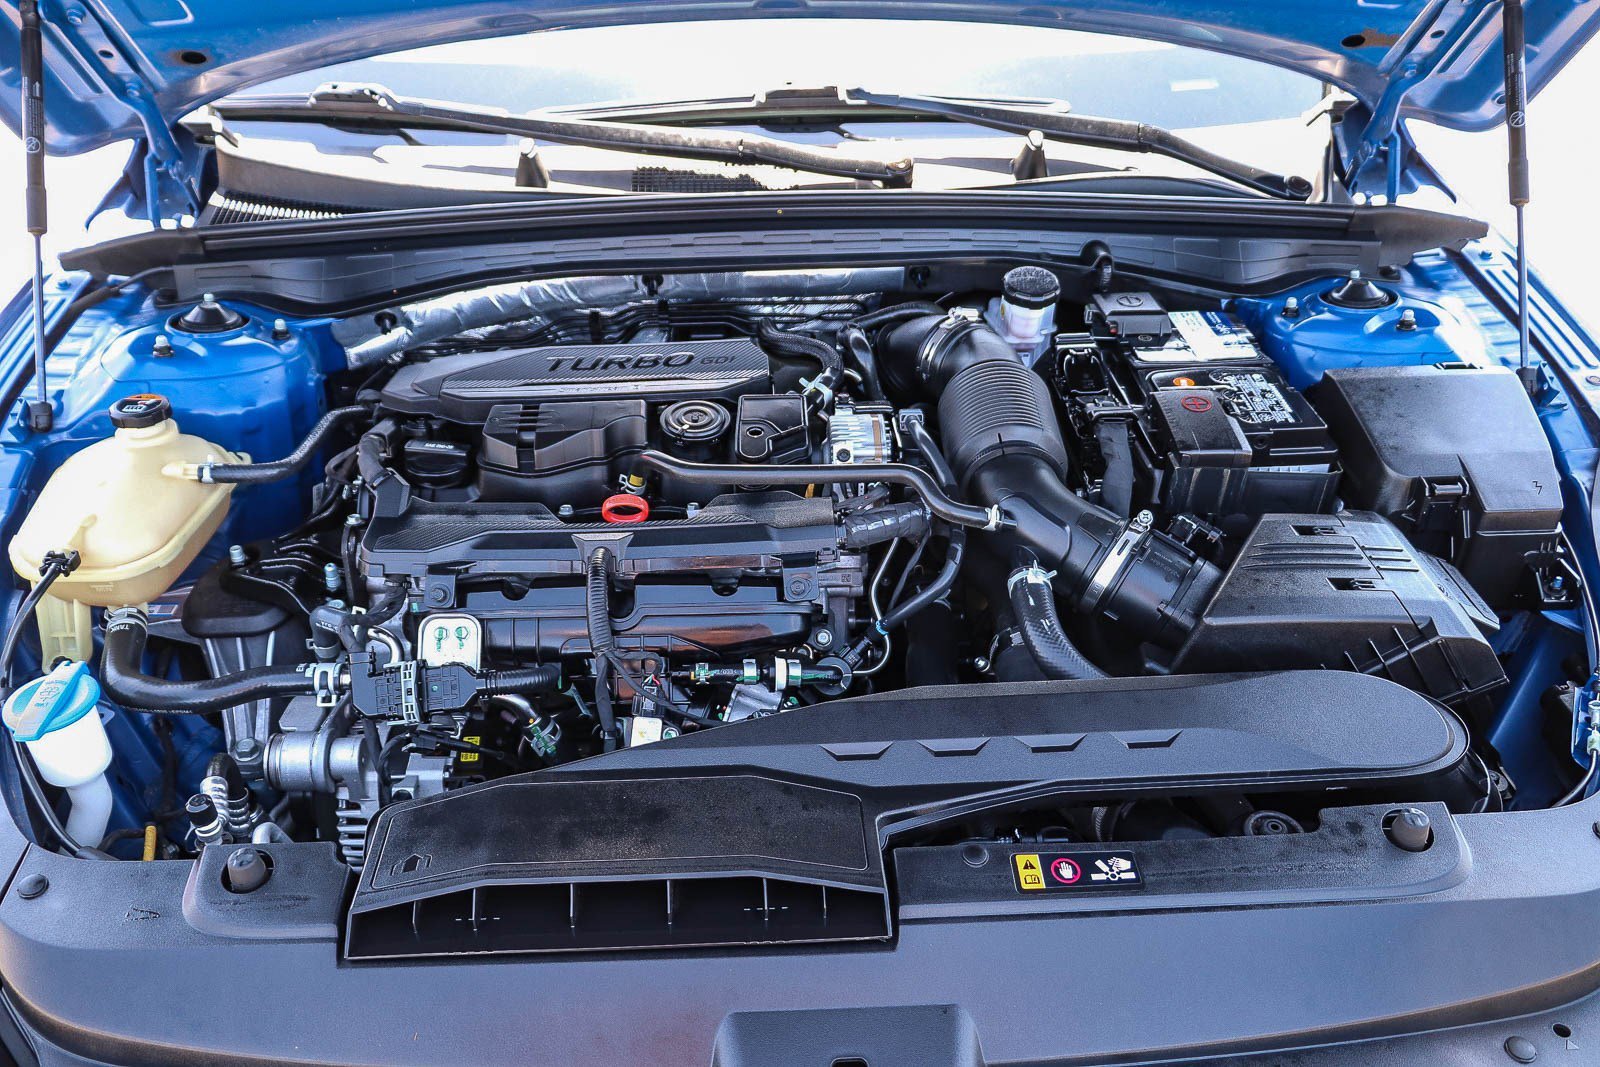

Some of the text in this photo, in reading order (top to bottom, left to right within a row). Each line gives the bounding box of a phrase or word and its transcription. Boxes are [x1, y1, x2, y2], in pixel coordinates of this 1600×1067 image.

[547, 351, 735, 372] TURBO GDI
[110, 624, 129, 633] TANK
